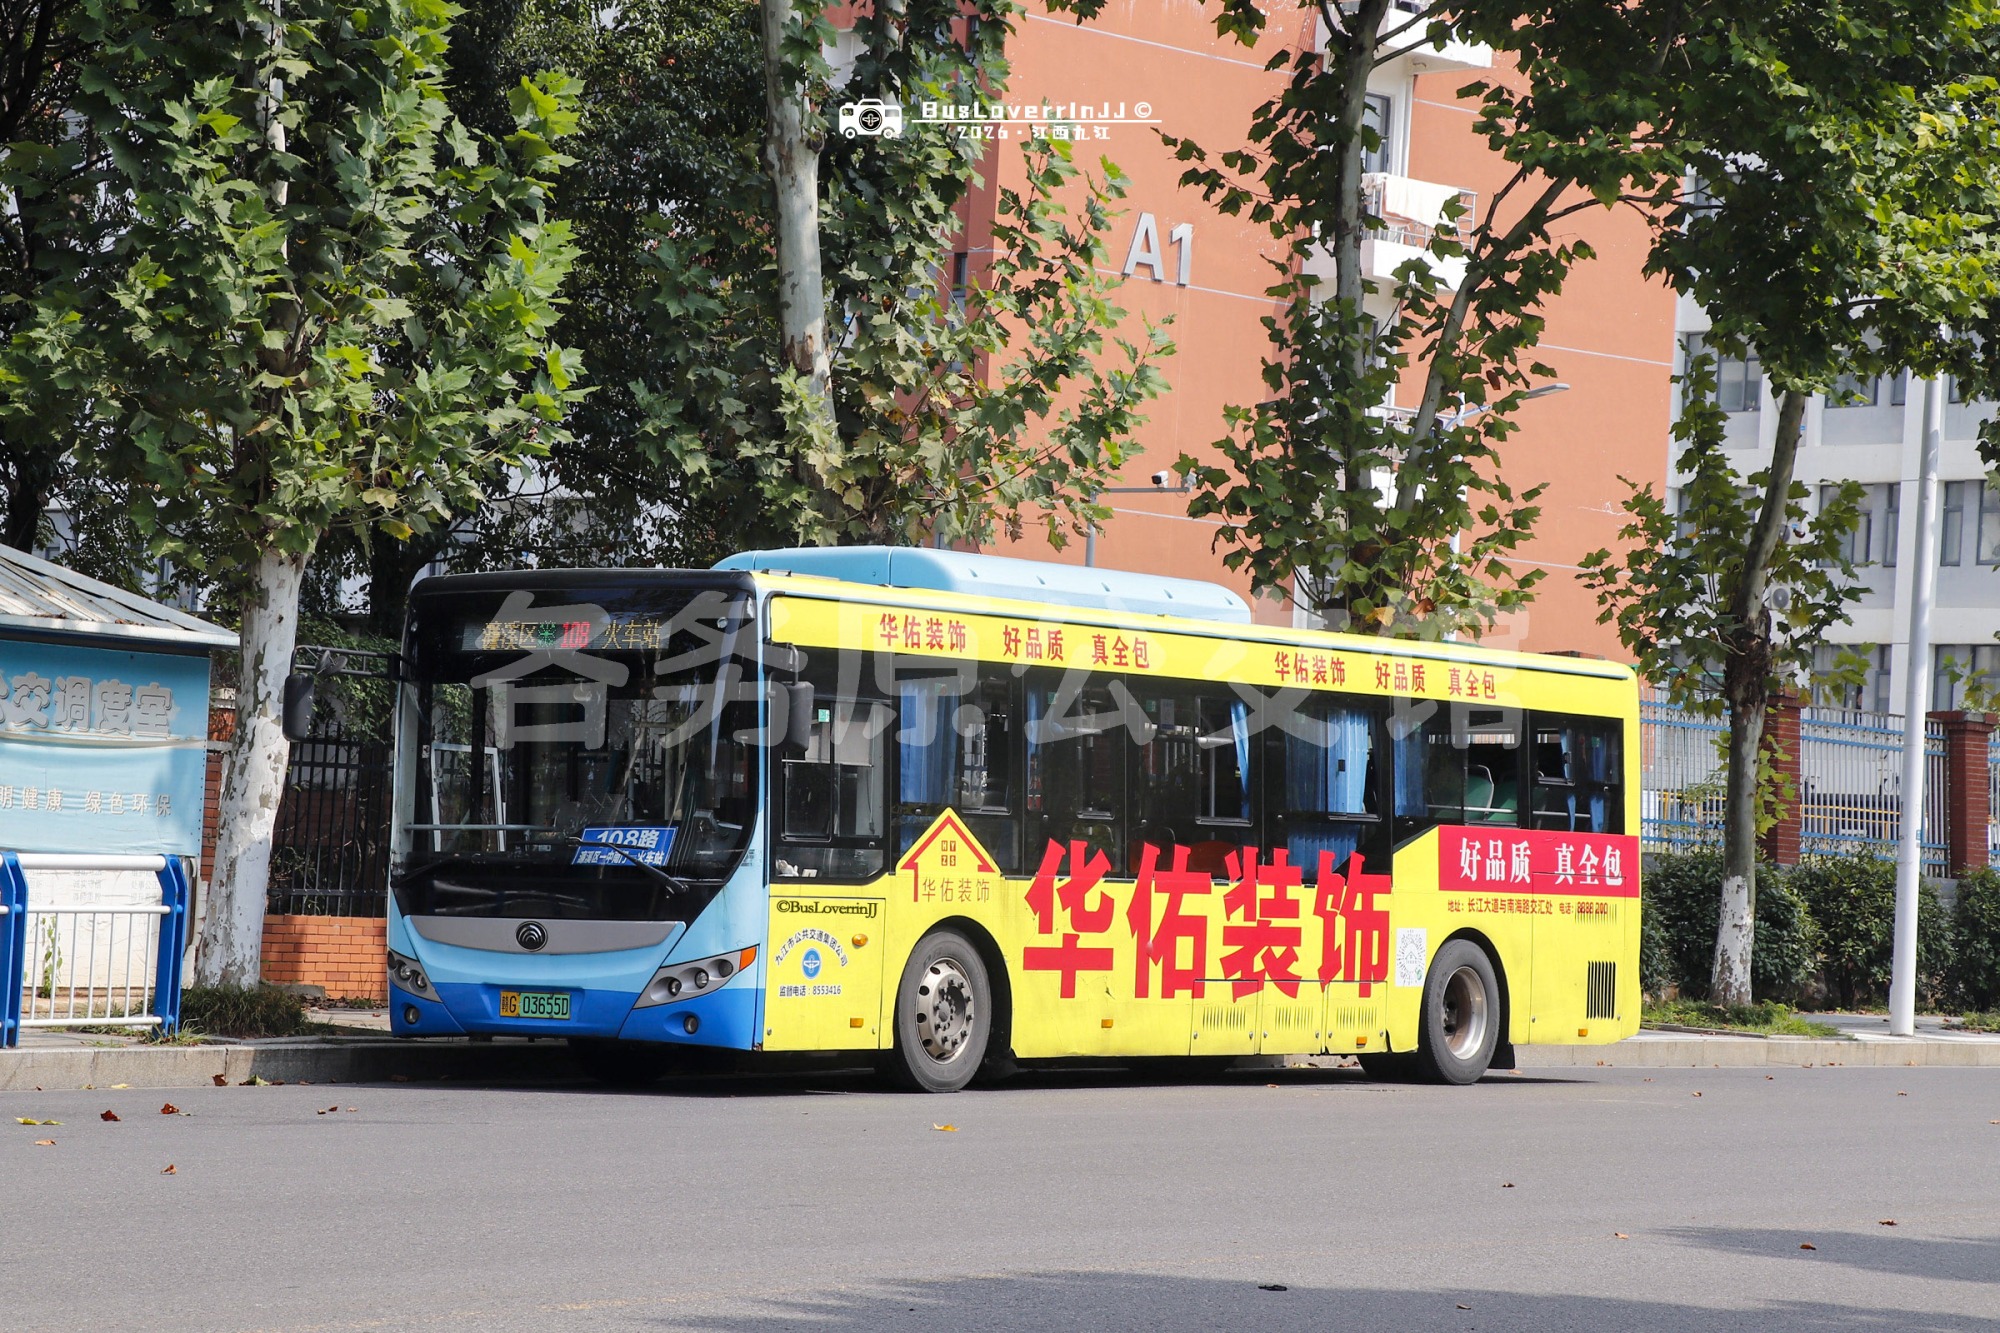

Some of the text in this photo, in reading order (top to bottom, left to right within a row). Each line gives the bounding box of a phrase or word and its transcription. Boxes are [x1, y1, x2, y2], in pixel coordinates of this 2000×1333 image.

[1121, 211, 1194, 286] A1
[560, 621, 592, 649] 108
[602, 619, 663, 650] 火车站
[879, 612, 1150, 669] 华佑装饰 好品质 真全包
[1274, 650, 1497, 700] 华佑装饰 好品质 真全包
[0, 670, 173, 738] 交调度室
[85, 790, 172, 818] 绿色环保
[597, 829, 660, 849] 108路
[1459, 837, 1623, 886] 好品质 真全包
[922, 877, 990, 903] 华佑装饰
[1023, 837, 1392, 1003] 华佑装饰
[775, 928, 848, 967] 九江市公共交通集团公司
